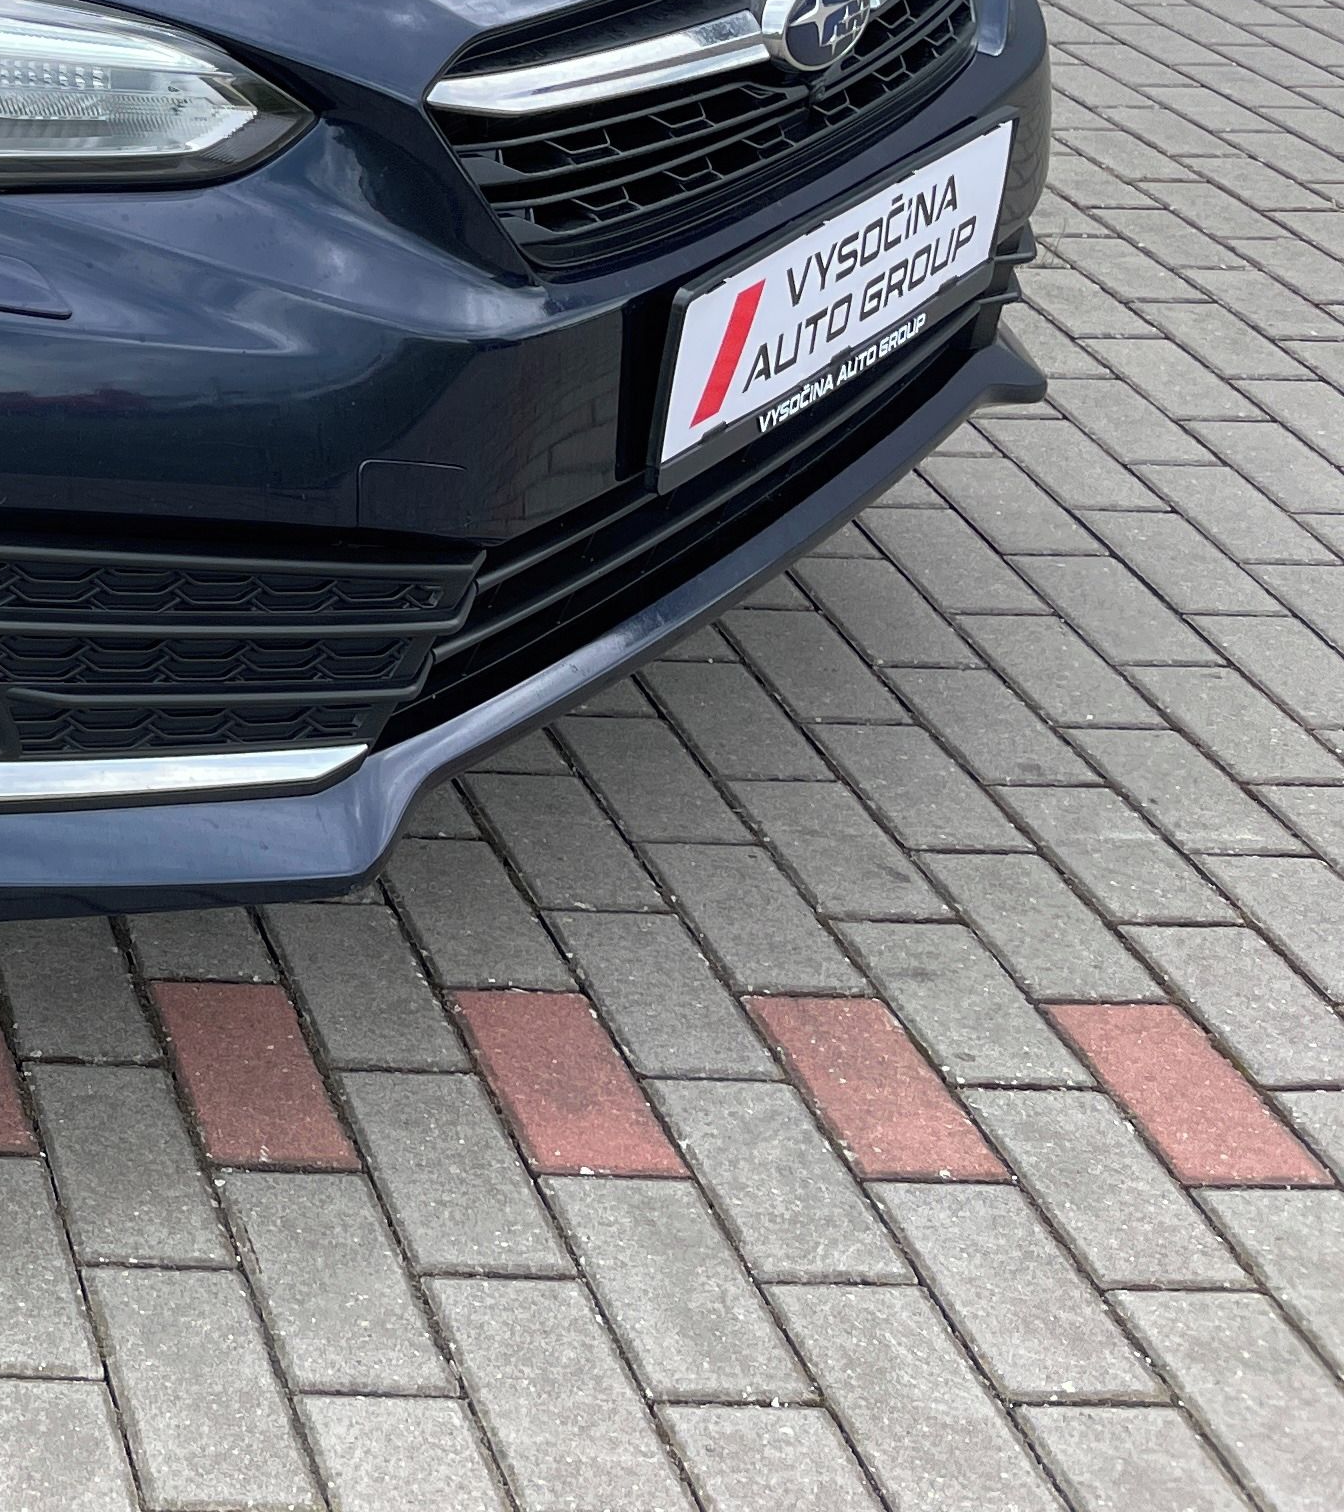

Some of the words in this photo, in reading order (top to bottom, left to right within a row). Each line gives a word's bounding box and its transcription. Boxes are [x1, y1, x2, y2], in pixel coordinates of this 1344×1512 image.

[742, 293, 853, 393] AUTO
[859, 215, 977, 322] GROUP
[787, 174, 958, 307] VYSOČINA
[758, 373, 834, 433] VYSOČINA
[836, 345, 877, 386] AUTO
[879, 313, 927, 358] GROUP
